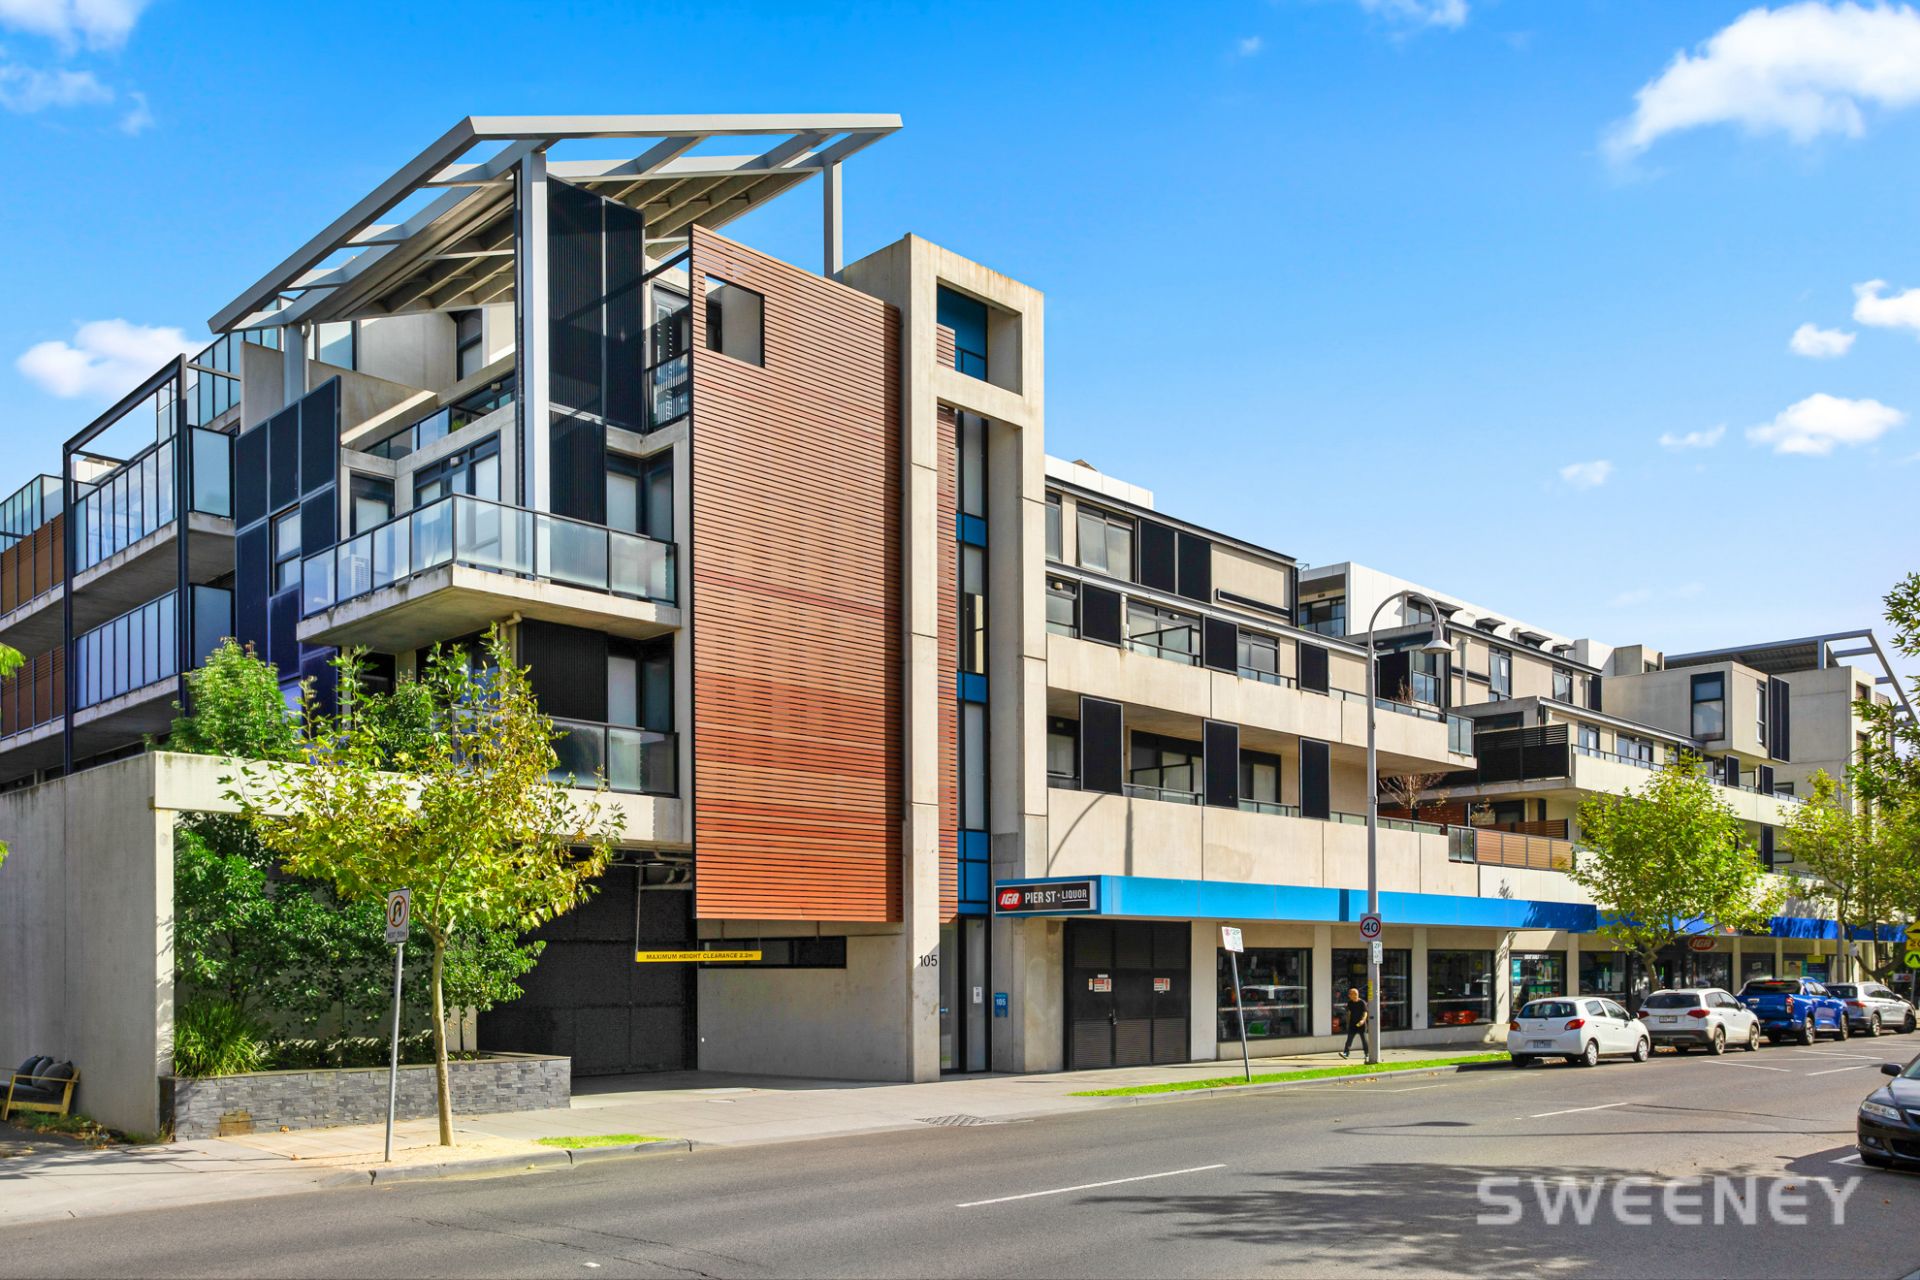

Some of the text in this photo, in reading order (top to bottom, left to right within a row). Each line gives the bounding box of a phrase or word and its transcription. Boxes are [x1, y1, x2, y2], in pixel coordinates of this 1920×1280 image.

[1000, 893, 1020, 905] IGA
[1025, 892, 1044, 904] PIER
[1045, 890, 1056, 902] ST
[1062, 888, 1087, 899] LIQUOR
[1364, 922, 1378, 932] 40
[919, 954, 938, 967] 105
